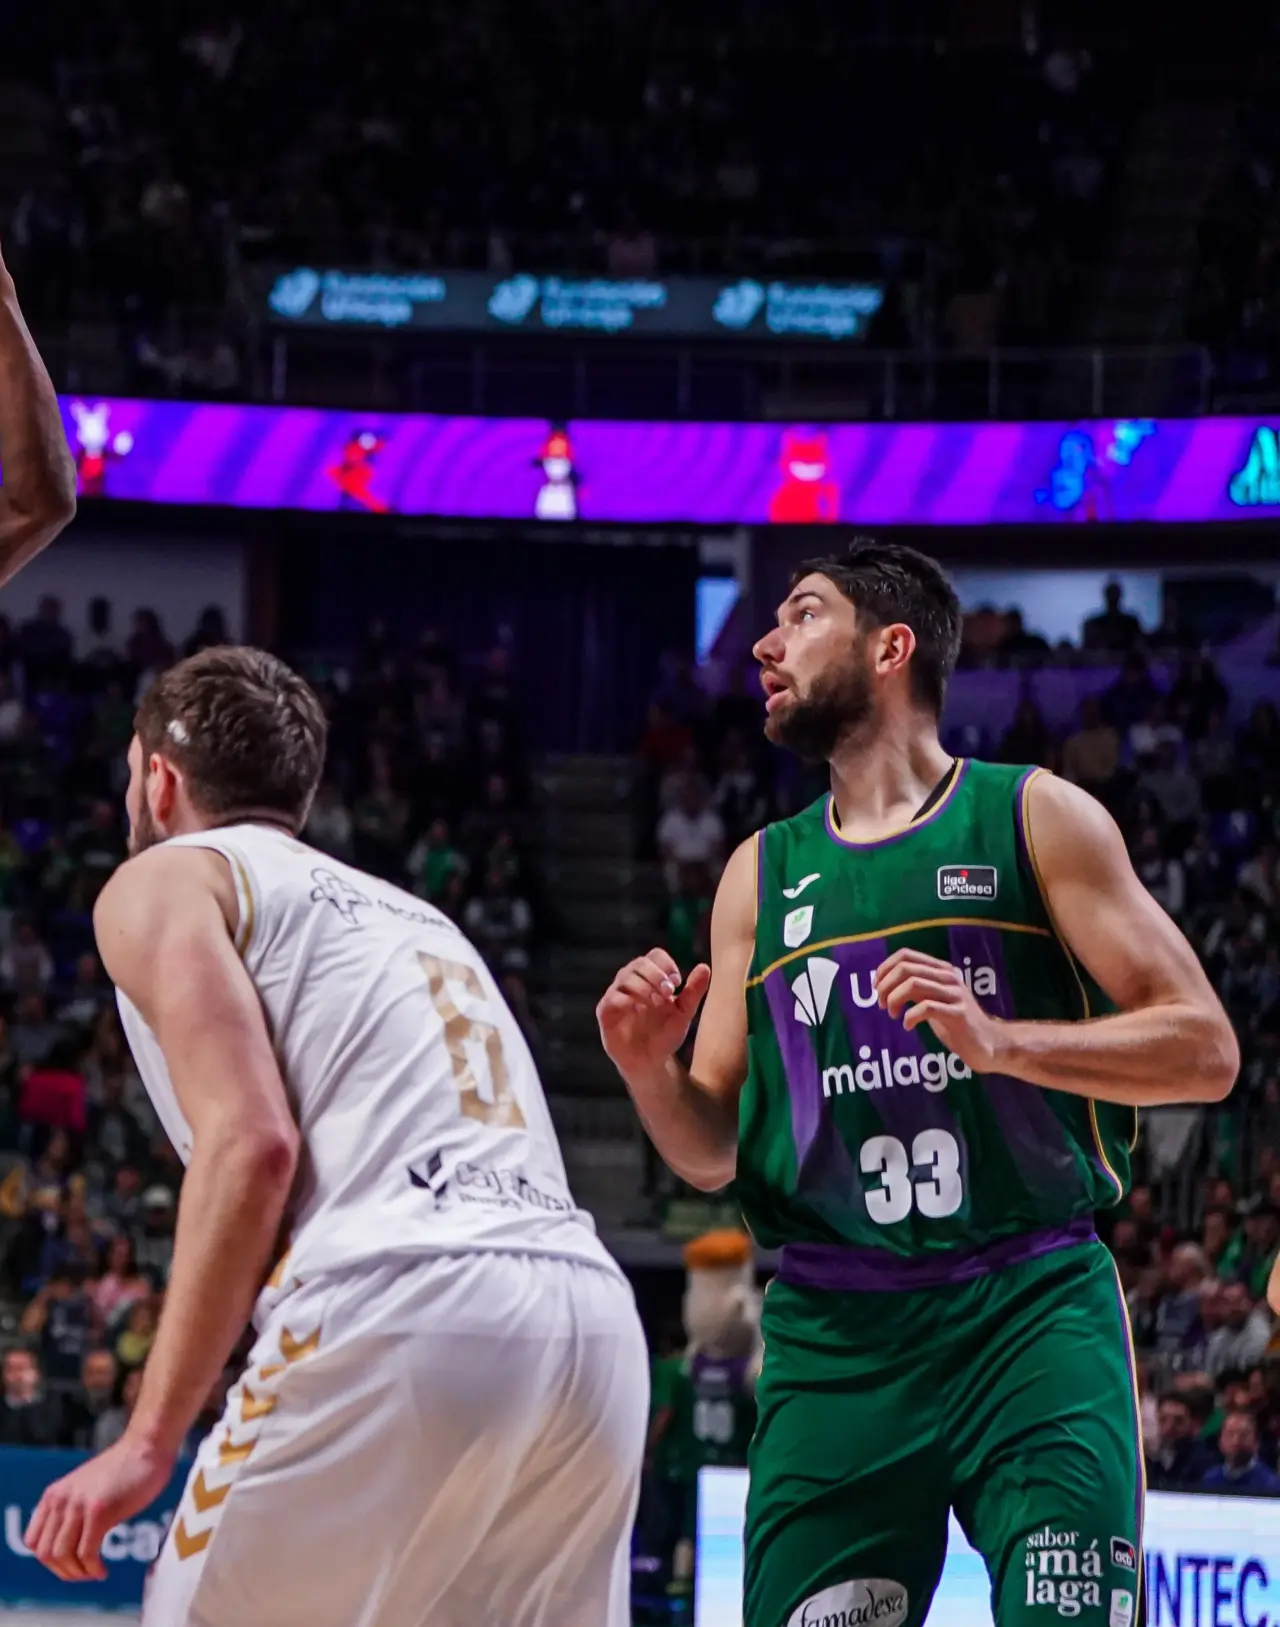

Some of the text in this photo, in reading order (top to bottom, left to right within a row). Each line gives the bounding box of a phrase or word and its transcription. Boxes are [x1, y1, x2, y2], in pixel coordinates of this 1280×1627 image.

[416, 949, 527, 1129] 6
[859, 1128, 963, 1225] 33
[1026, 1526, 1080, 1548] sabor
[1025, 1569, 1102, 1617] laga
